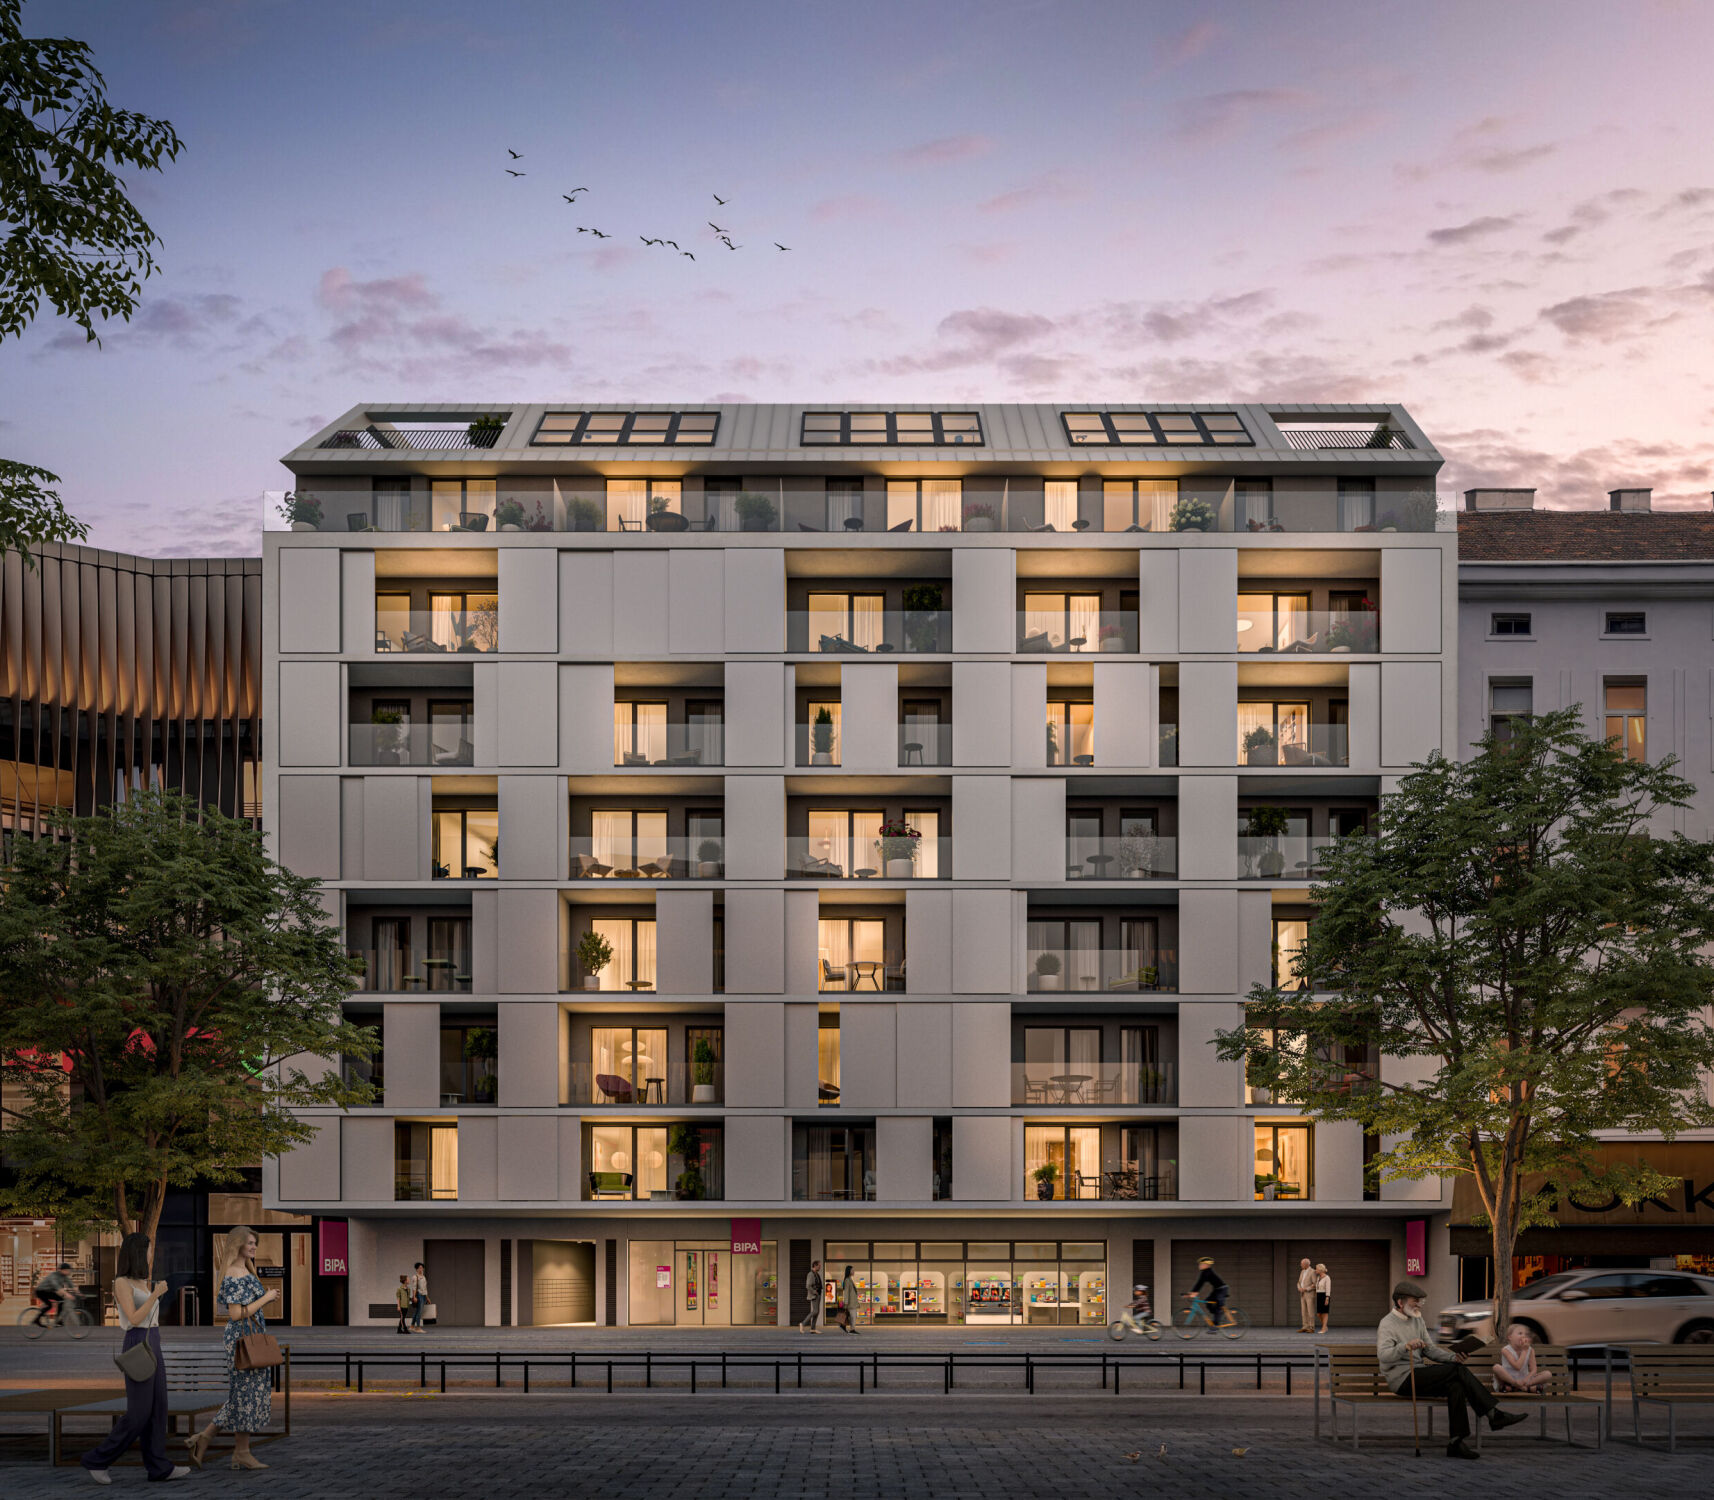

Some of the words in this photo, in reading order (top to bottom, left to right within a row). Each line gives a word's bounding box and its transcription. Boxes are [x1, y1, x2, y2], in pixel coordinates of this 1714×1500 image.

[733, 1242, 759, 1253] BIPA
[324, 1258, 346, 1272] BIPA
[1407, 1258, 1421, 1272] BIPA
